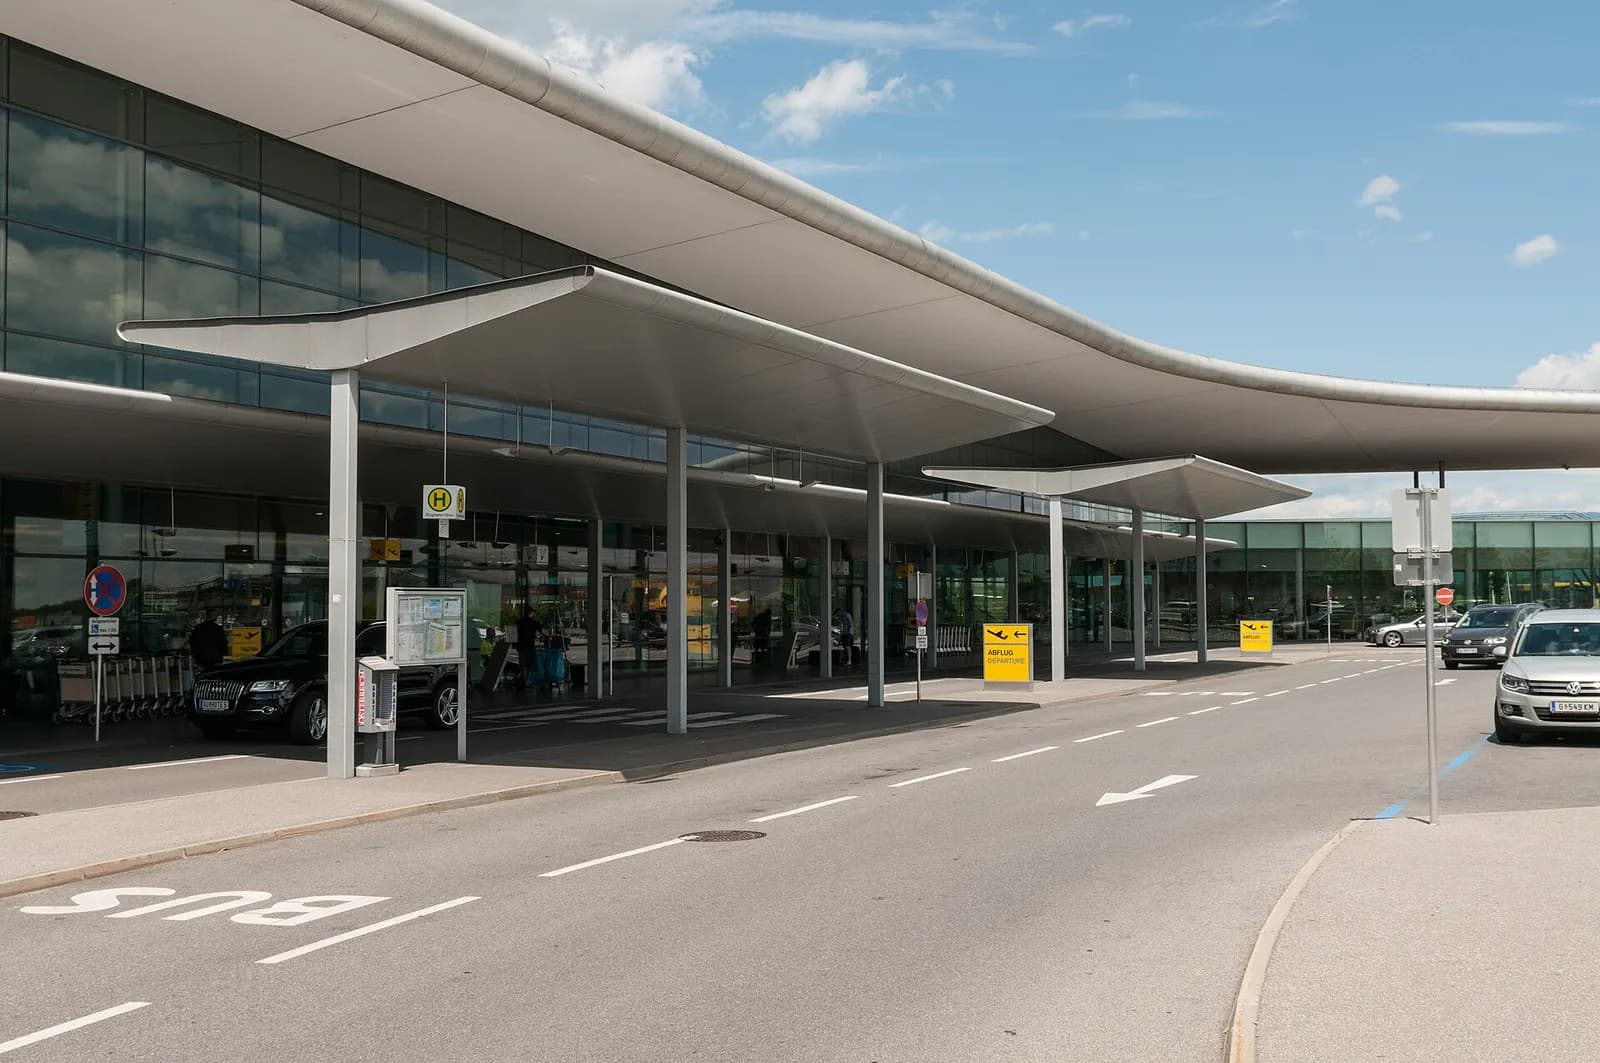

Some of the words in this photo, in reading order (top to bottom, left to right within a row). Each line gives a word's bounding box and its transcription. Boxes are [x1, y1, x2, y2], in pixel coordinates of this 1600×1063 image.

[433, 492, 446, 507] H
[987, 657, 1024, 665] DEPARTURE
[20, 886, 391, 926] BUS
